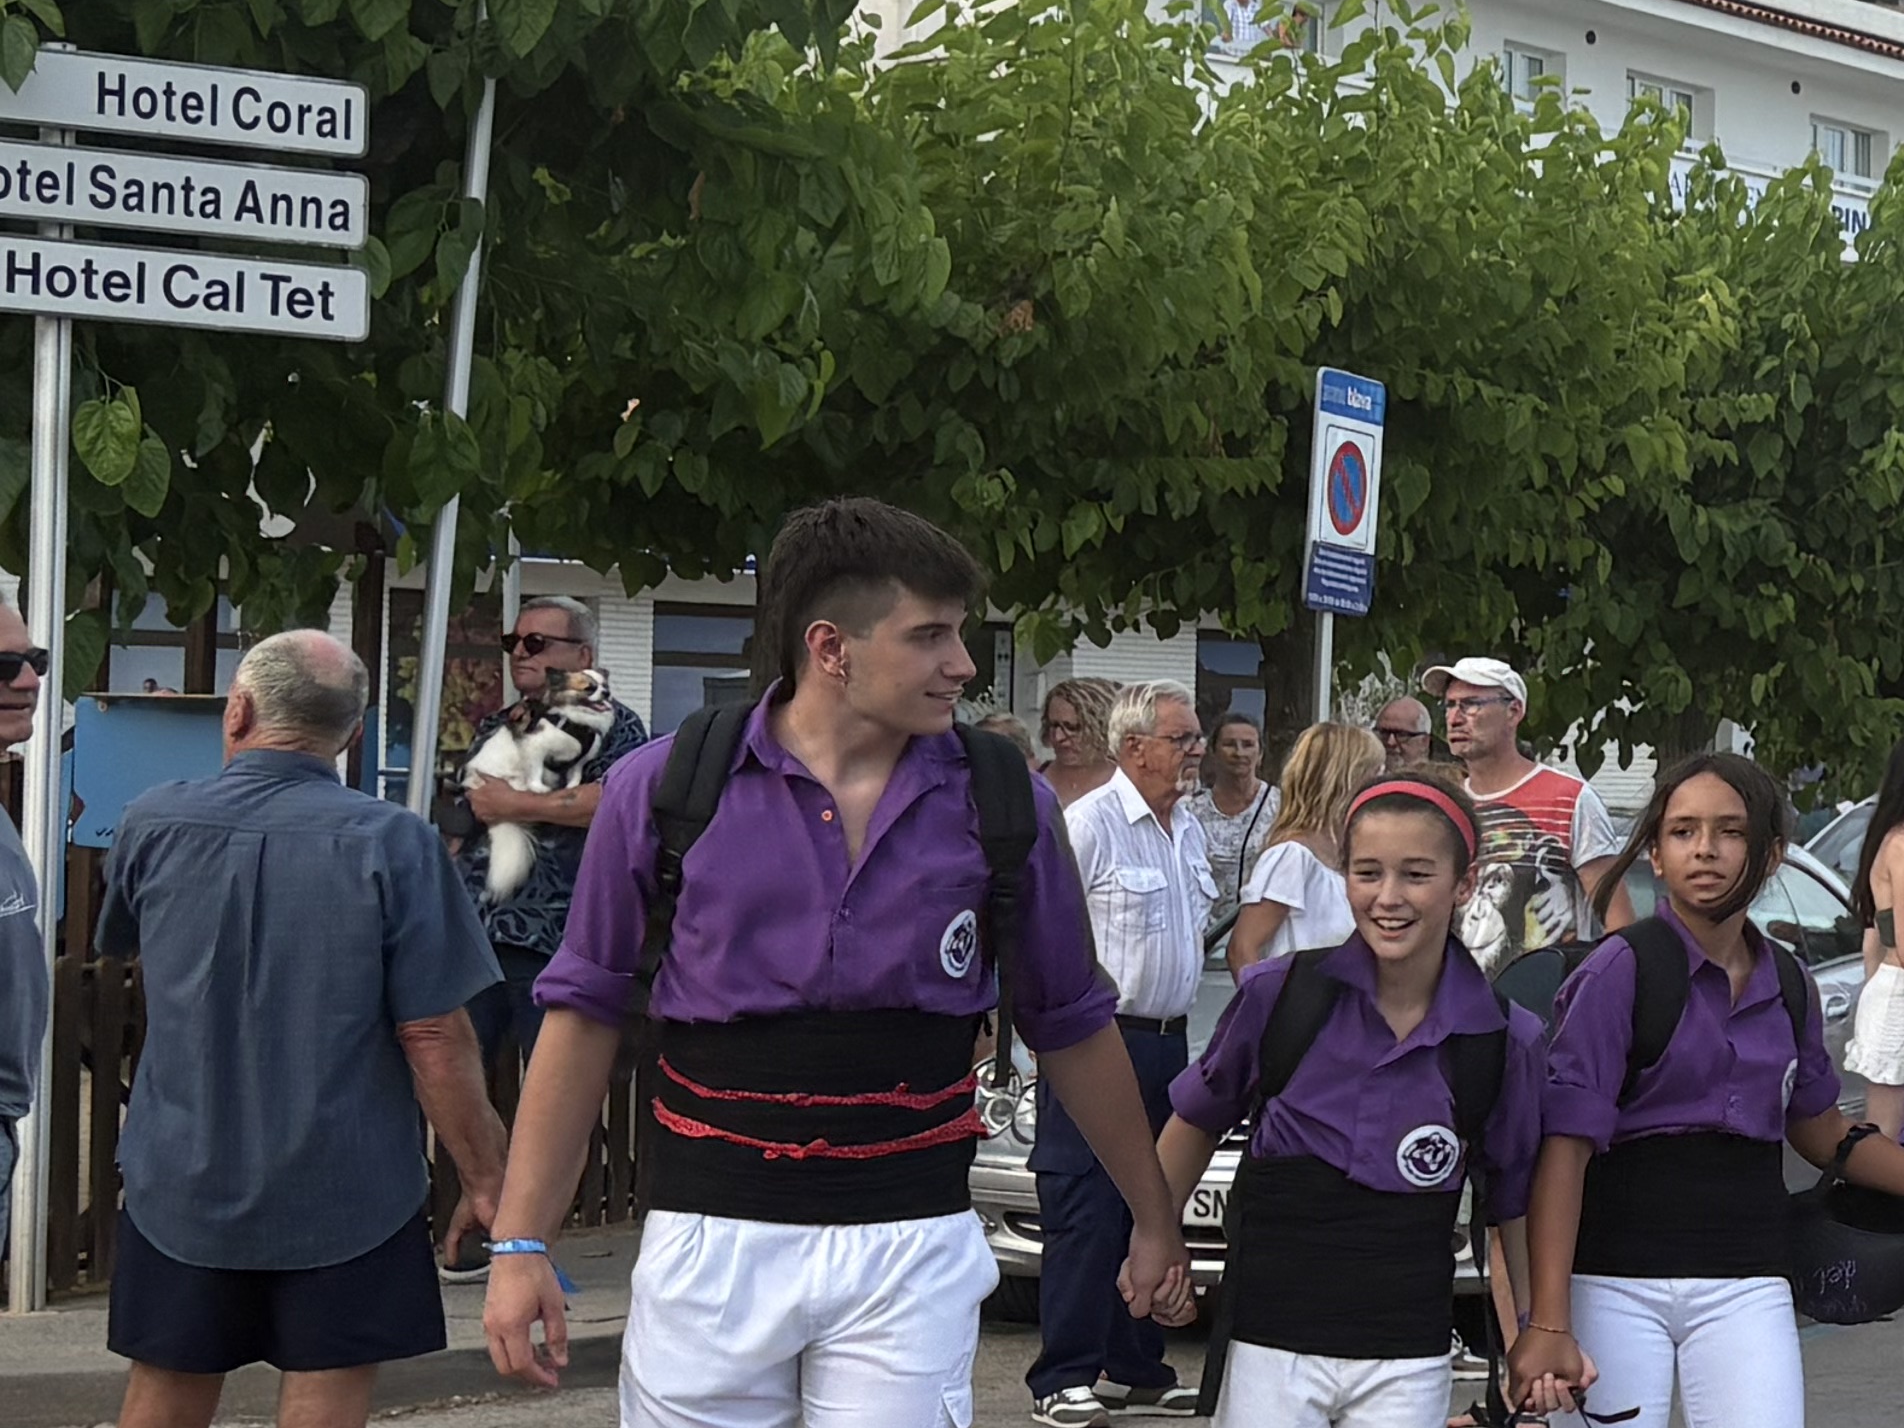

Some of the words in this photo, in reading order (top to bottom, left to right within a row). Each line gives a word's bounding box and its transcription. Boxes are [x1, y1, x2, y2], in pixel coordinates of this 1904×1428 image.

[97, 71, 218, 126] Hotel
[232, 87, 352, 140] Coral
[0, 159, 75, 206] tel
[88, 164, 222, 220] Santa
[234, 180, 350, 232] Anna
[5, 250, 146, 304] Hotel
[162, 263, 245, 314] Cal
[259, 272, 336, 321] Tet
